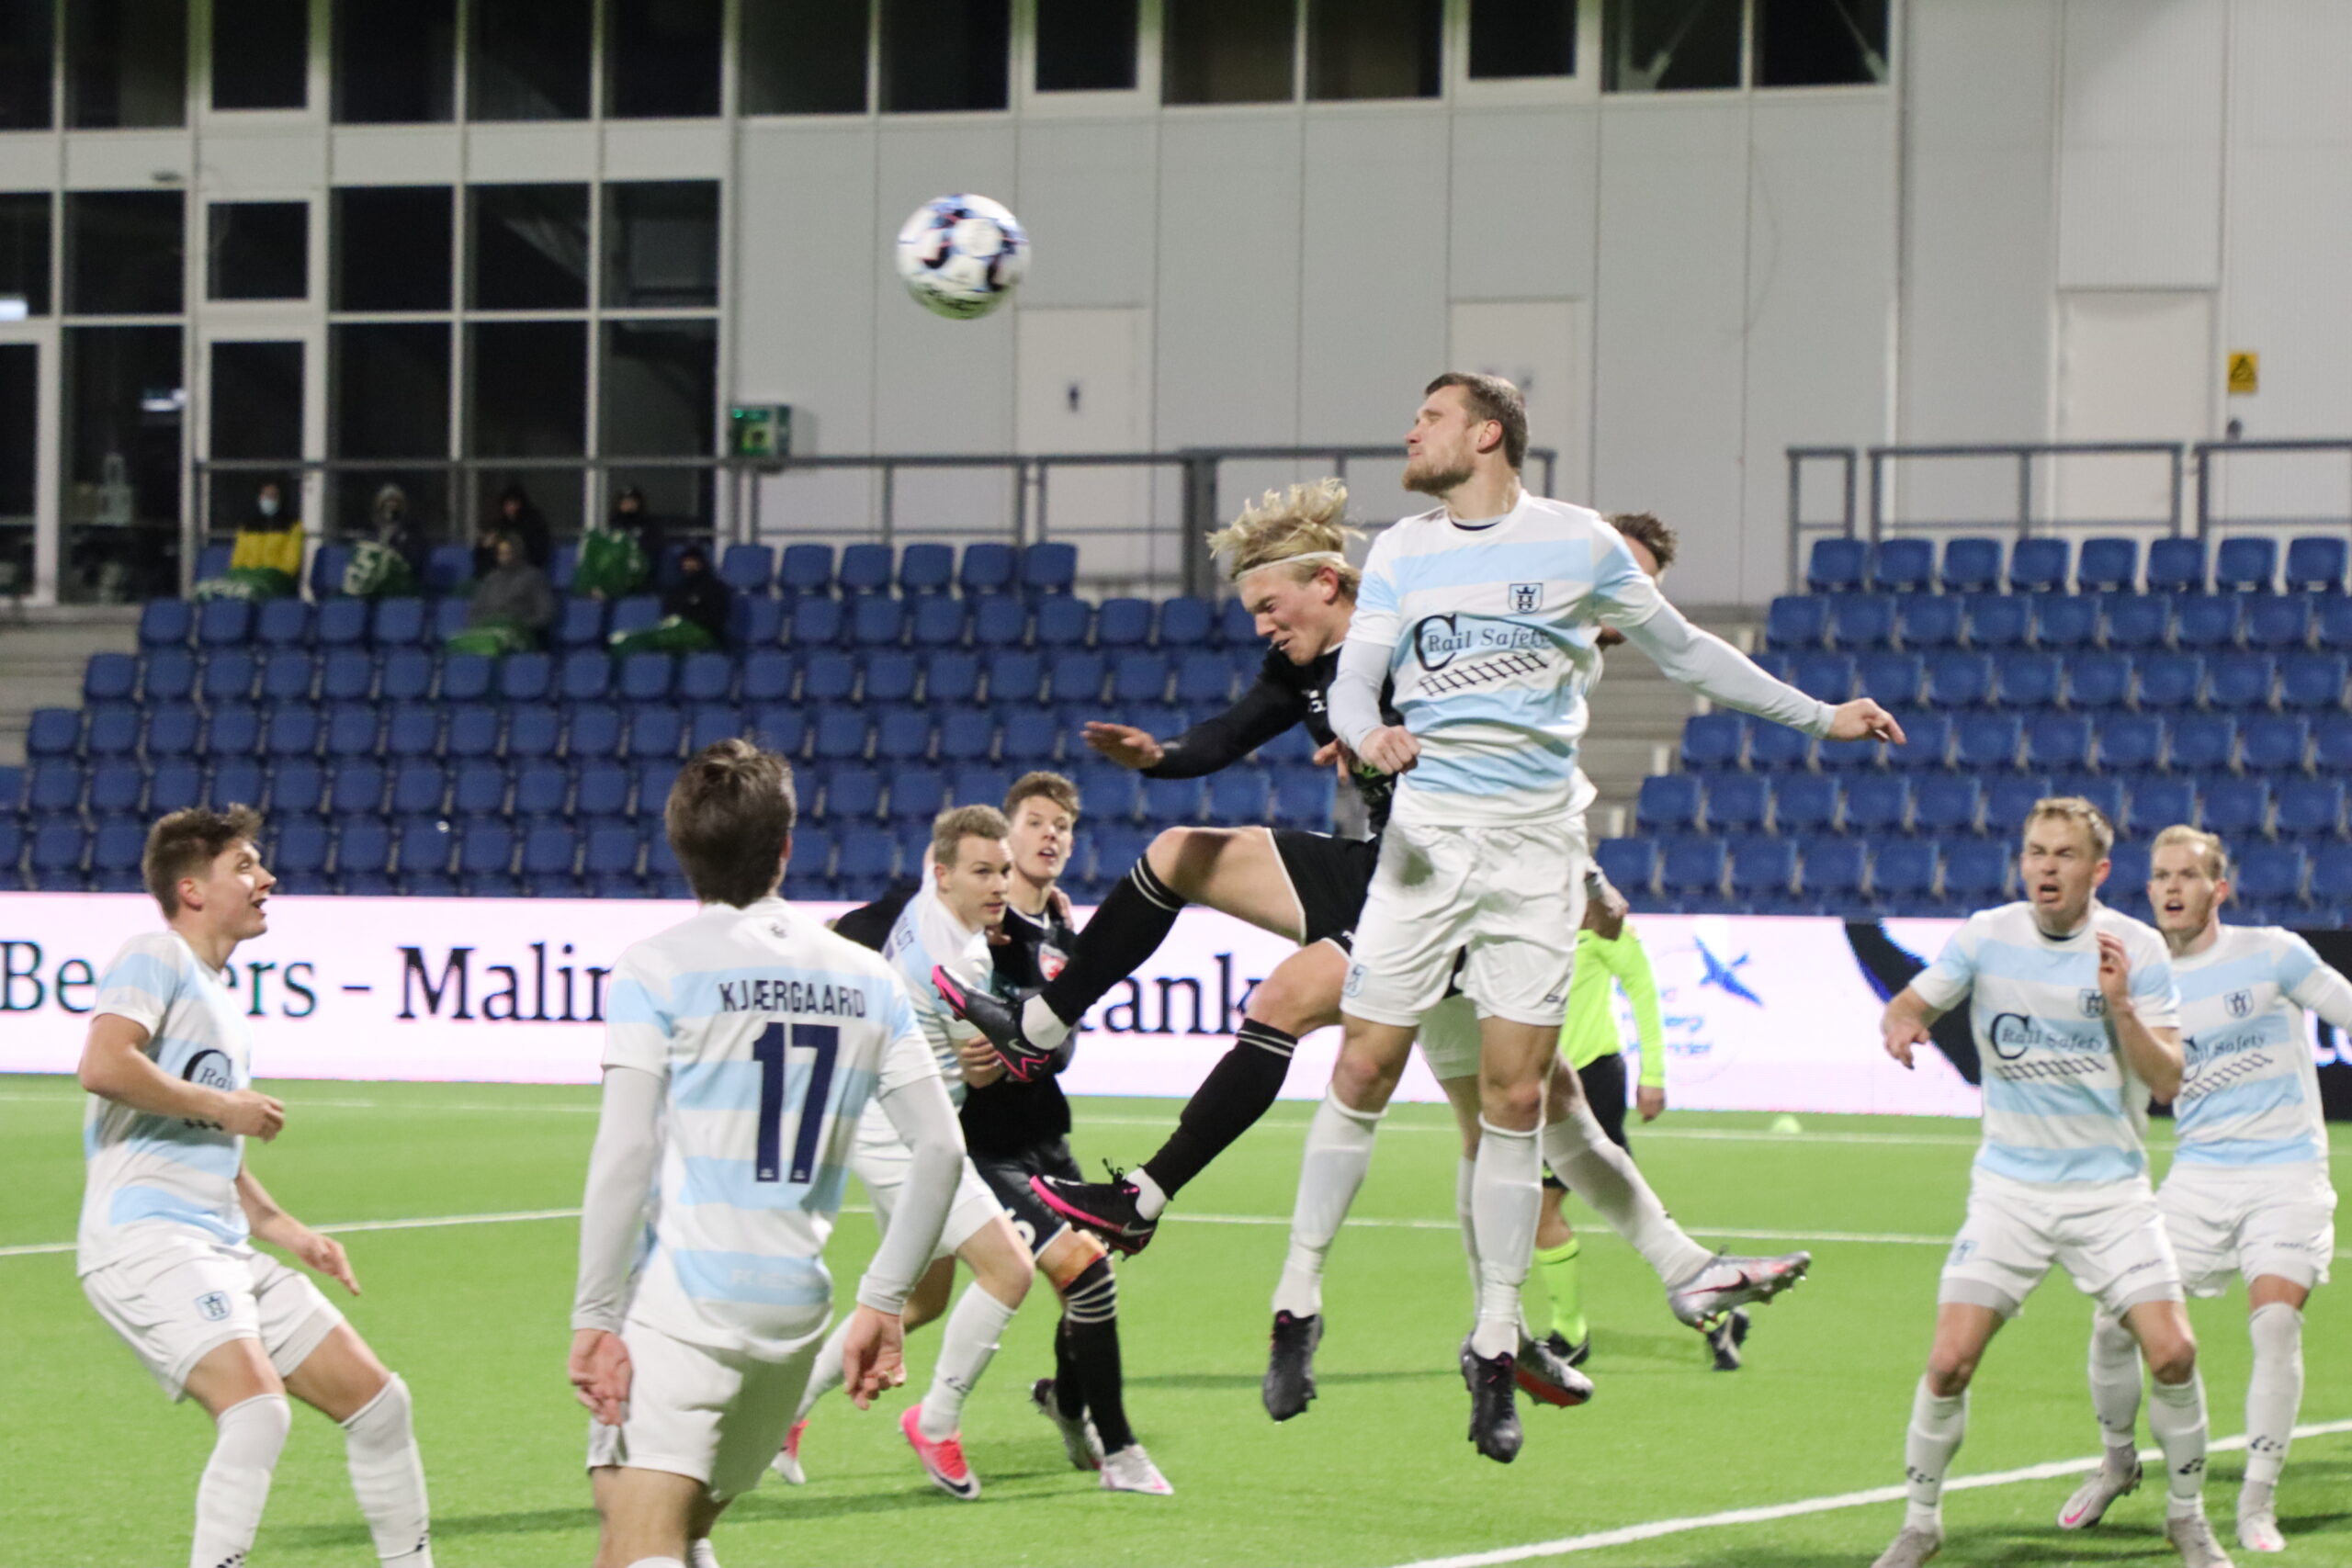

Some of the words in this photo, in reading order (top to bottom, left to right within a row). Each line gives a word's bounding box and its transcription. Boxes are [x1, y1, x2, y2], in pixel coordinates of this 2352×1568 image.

[1429, 630, 1471, 652] Rail
[718, 979, 866, 1018] KJÆRGAARD
[2214, 1033, 2266, 1056] Safety
[752, 1021, 840, 1184] 17
